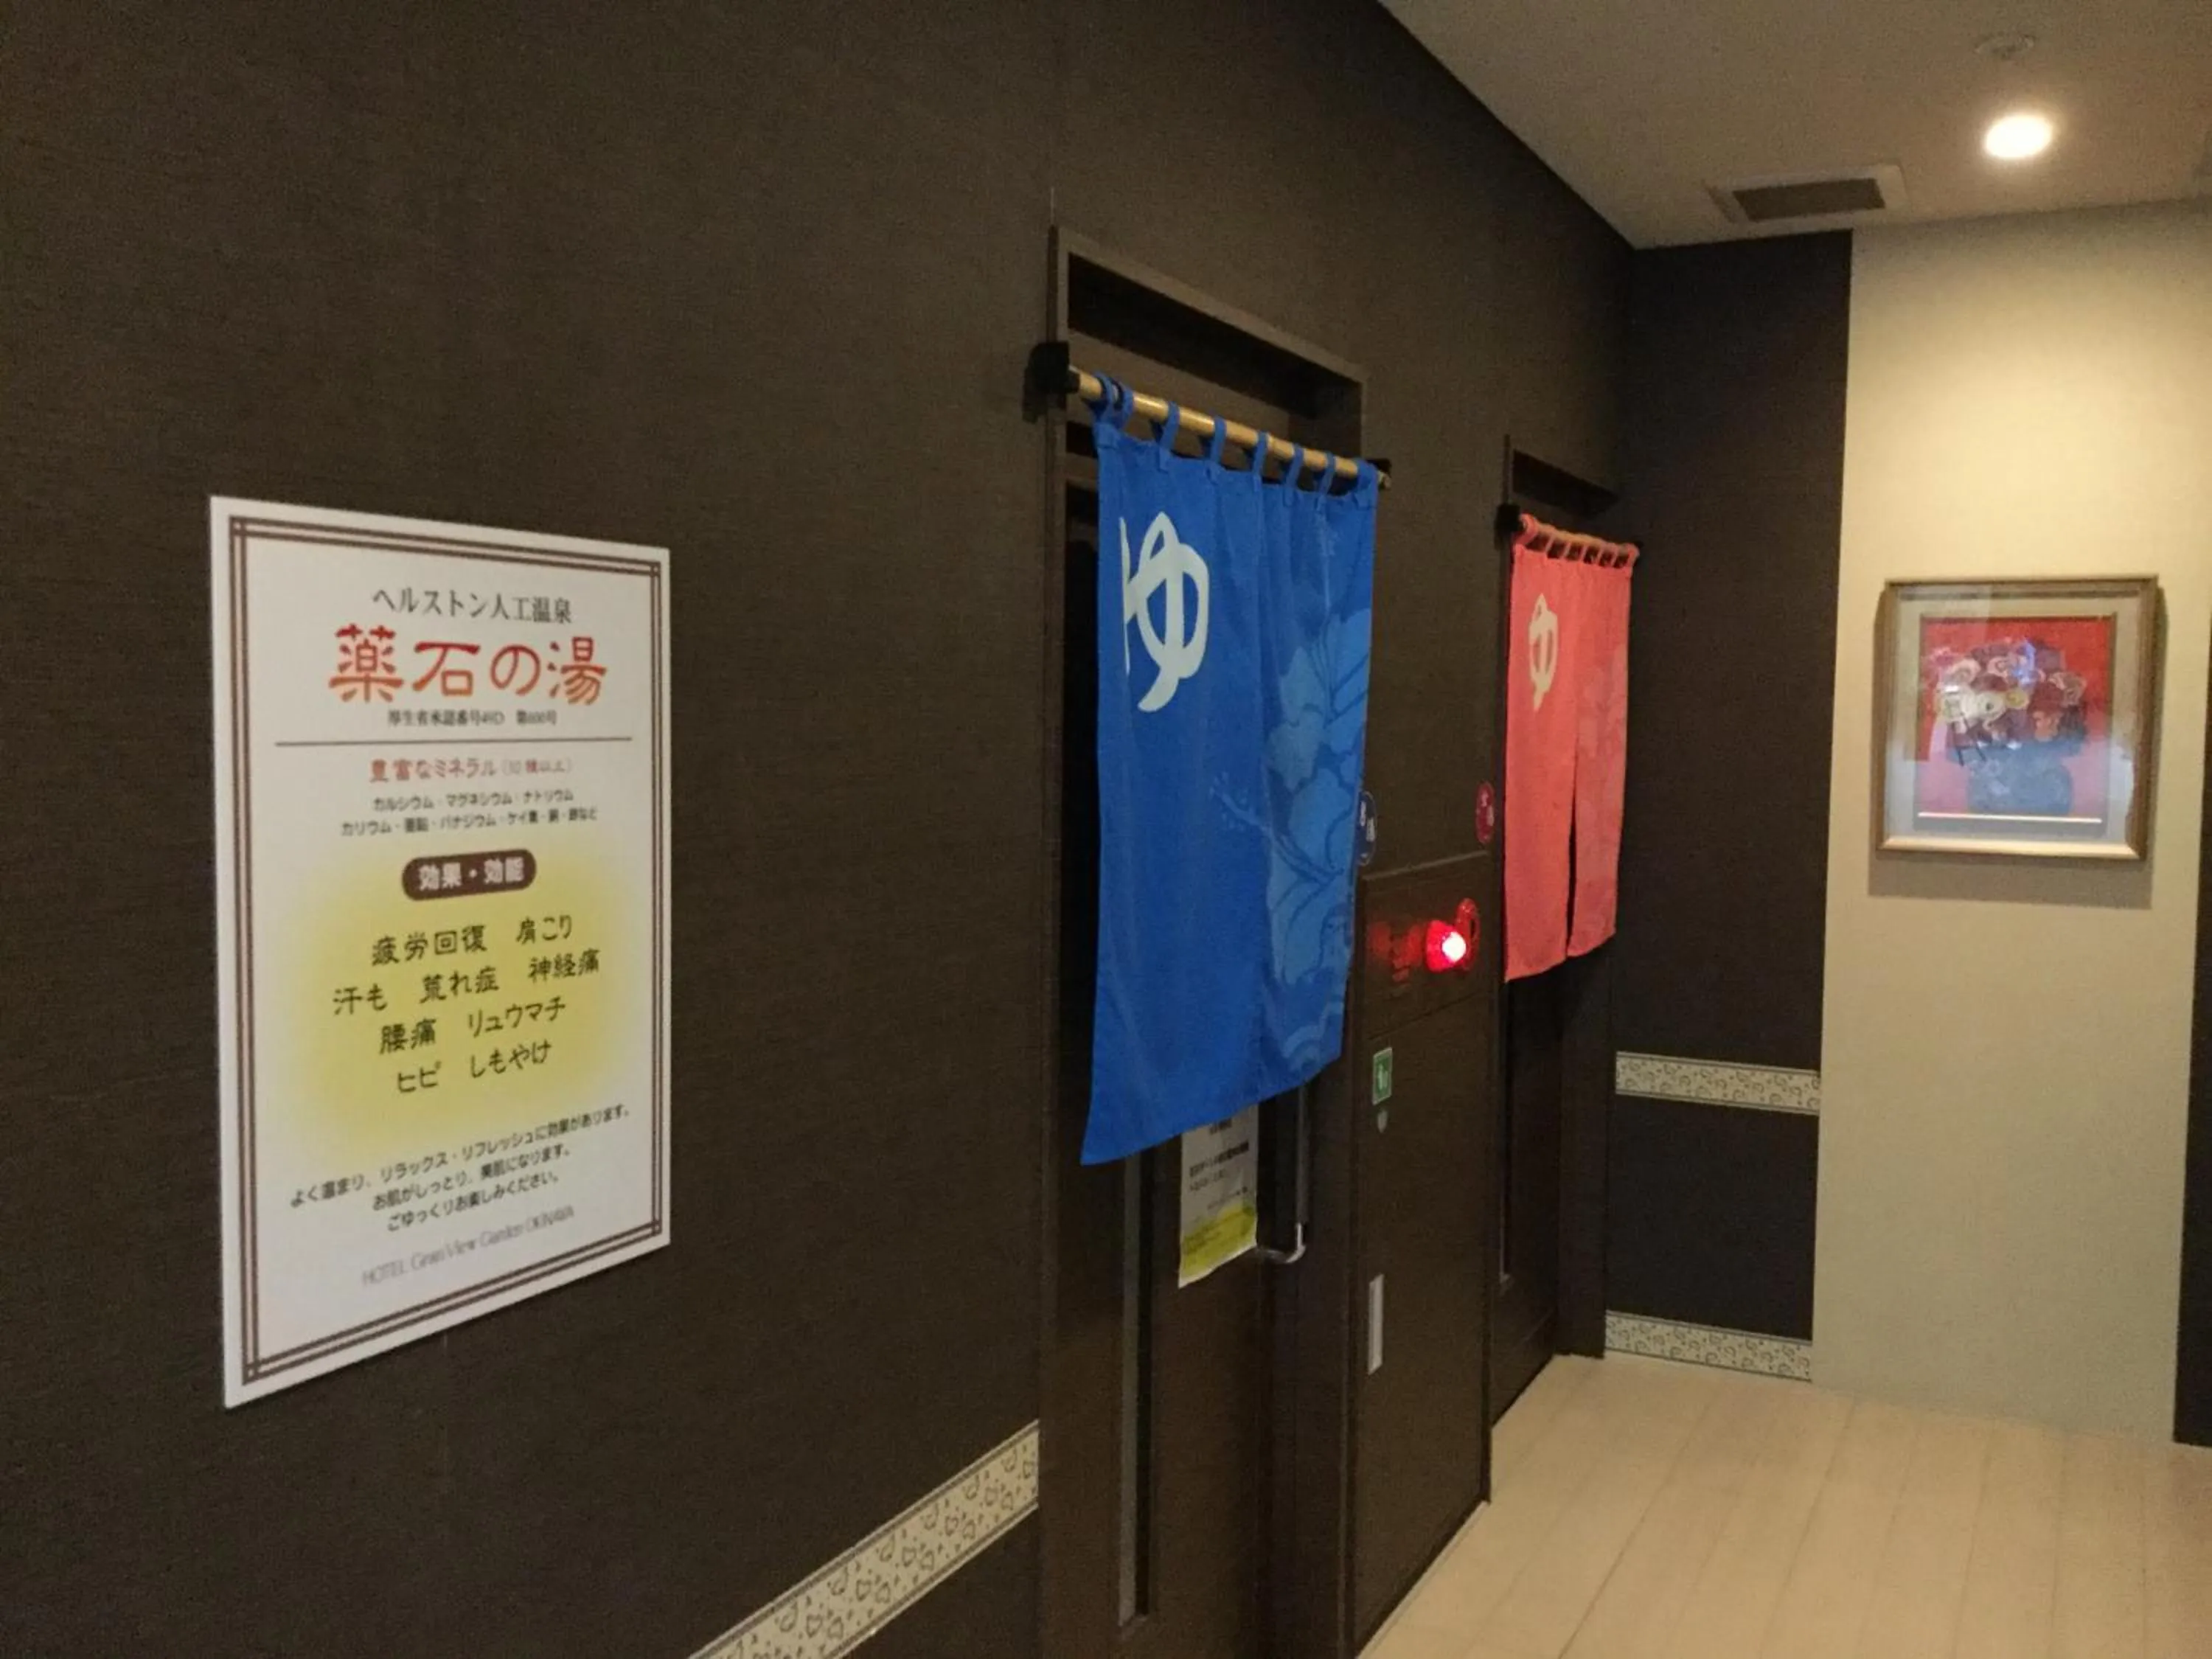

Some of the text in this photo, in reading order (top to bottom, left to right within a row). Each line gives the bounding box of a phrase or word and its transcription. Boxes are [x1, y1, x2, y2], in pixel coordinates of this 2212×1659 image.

[372, 587, 572, 624] ヘルストン人工温泉
[1119, 511, 1210, 712] ゆ
[328, 622, 608, 706] 薬石の湯
[1528, 592, 1558, 712] ゆ
[369, 757, 496, 783] 豊富なミネラル
[419, 858, 525, 891] 効果・効能
[371, 915, 572, 967] 疲労回復 肩こり
[333, 948, 601, 1016] 汗も 荒れ症 神経痛
[379, 996, 566, 1055] 腰痛 リュウマチ
[469, 1041, 553, 1079] しもやけ
